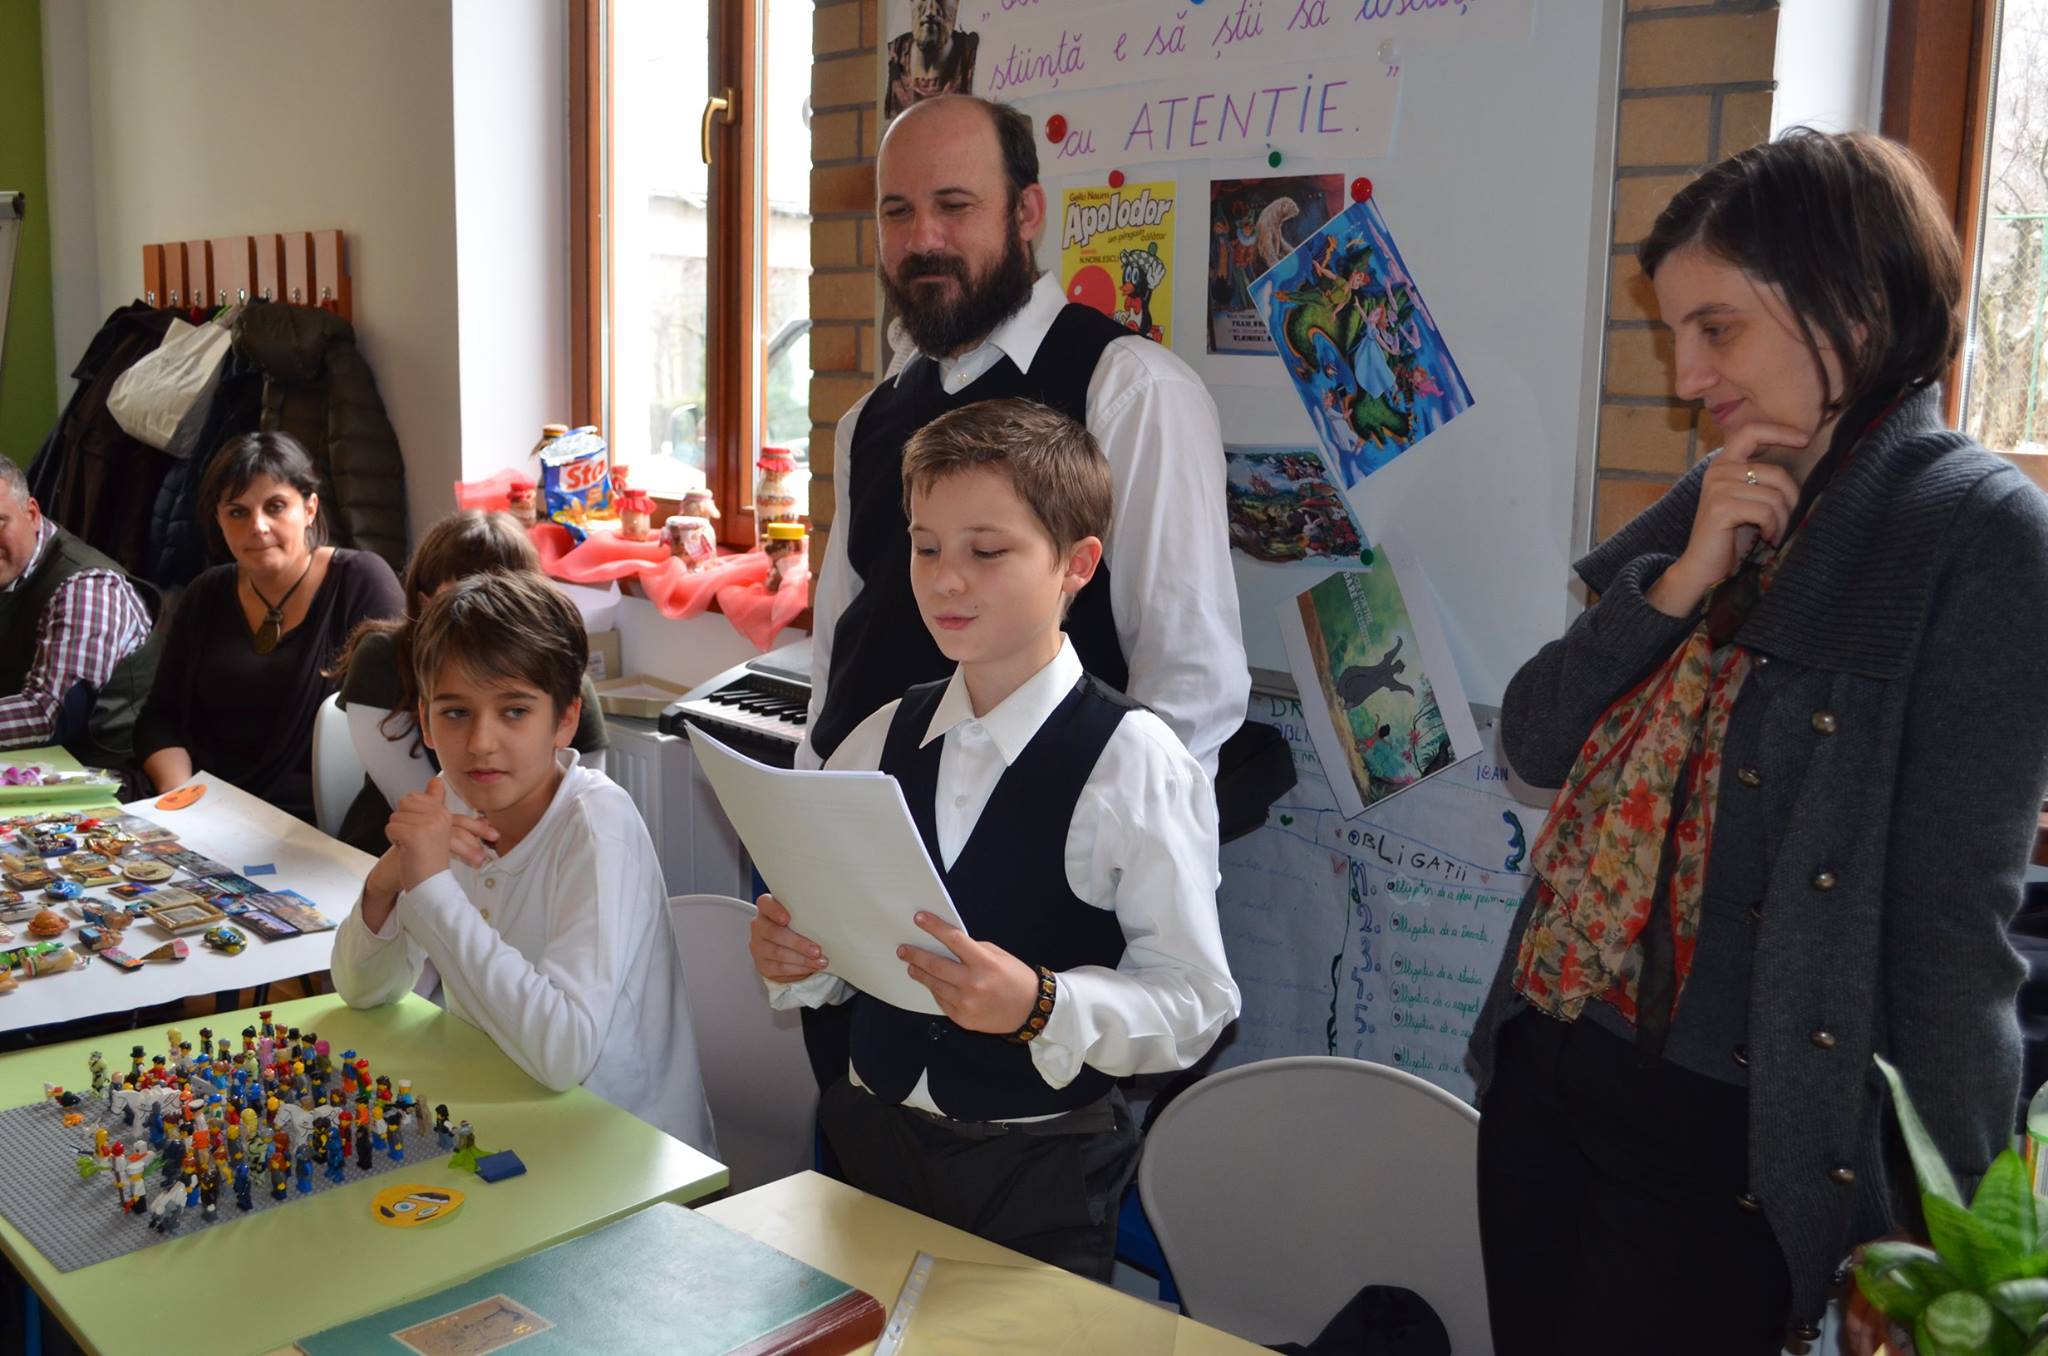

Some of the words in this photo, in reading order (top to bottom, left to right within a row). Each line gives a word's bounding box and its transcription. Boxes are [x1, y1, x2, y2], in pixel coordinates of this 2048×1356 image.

[1113, 33, 1128, 62] e
[1144, 10, 1188, 57] să
[1057, 128, 1097, 160] cu
[1062, 188, 1173, 250] Apolodor
[1357, 903, 1381, 934] 2.
[1361, 936, 1381, 973] 3.
[1354, 1003, 1376, 1034] 5.
